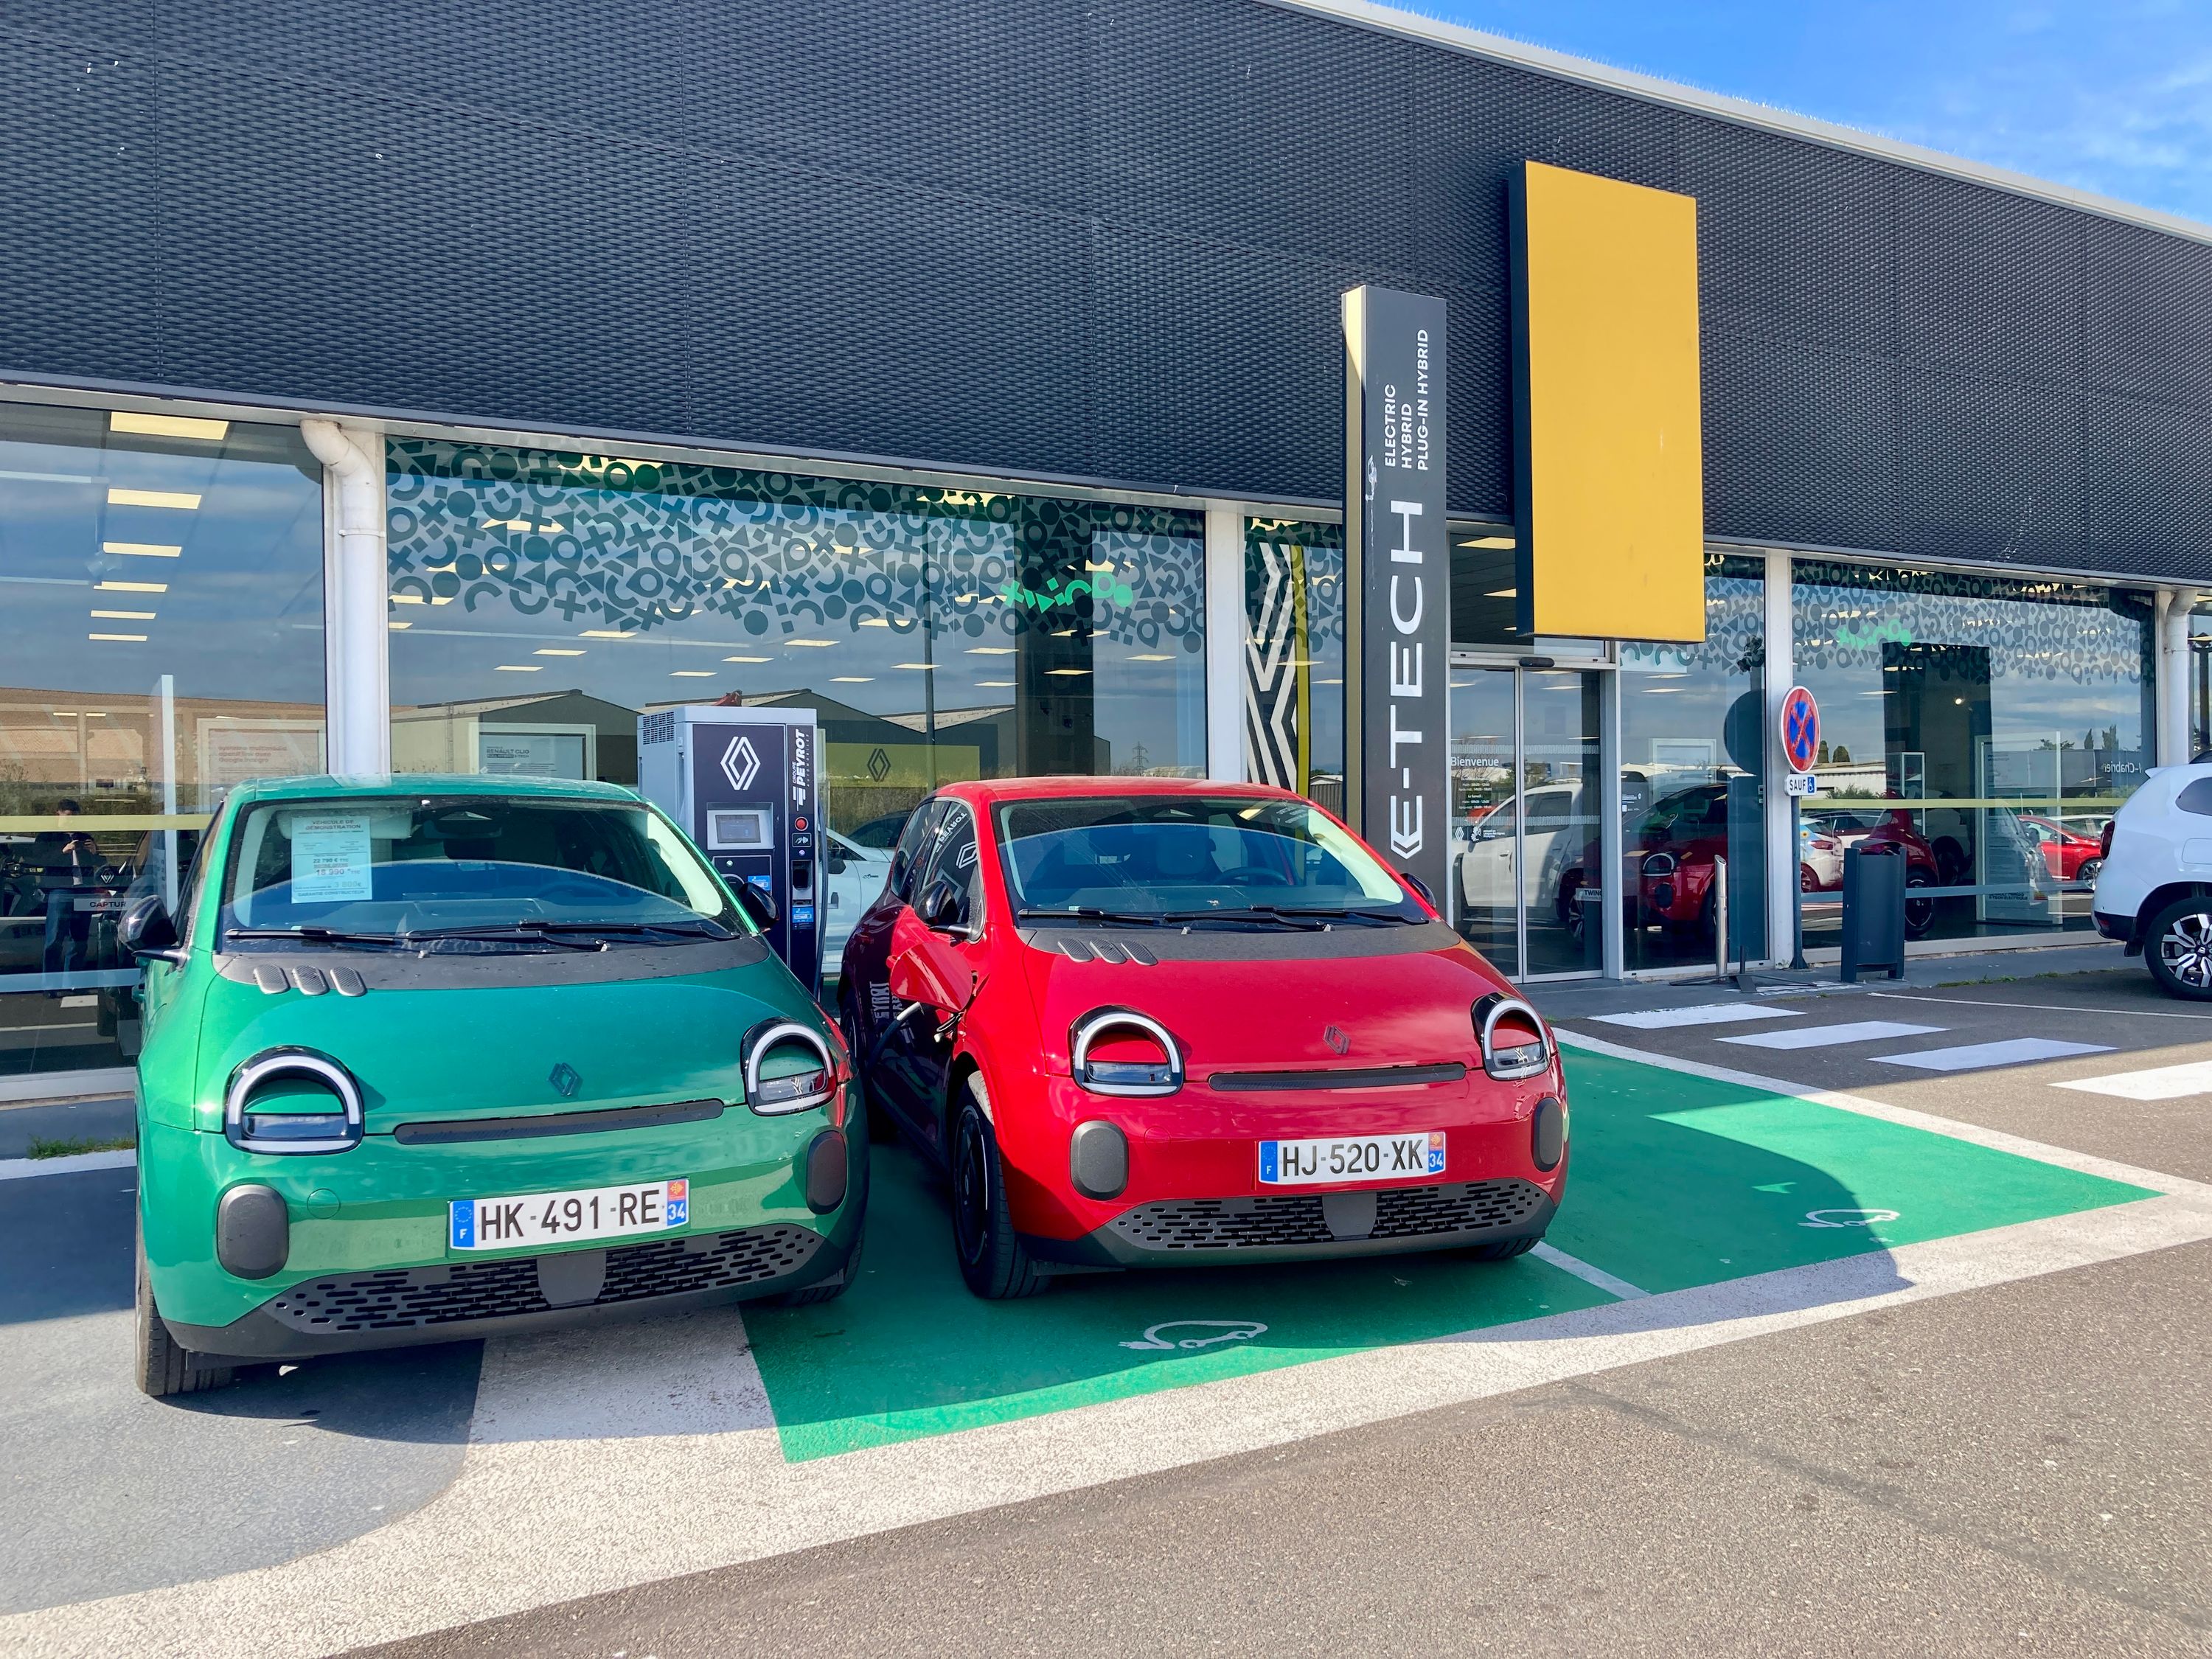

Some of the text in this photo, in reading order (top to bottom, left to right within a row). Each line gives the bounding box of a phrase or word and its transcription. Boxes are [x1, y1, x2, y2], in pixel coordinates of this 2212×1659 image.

[1385, 383, 1396, 467] ELECTRIC
[1417, 329, 1428, 470] PLUG-IN HYBRID
[1401, 403, 1412, 469] HYBRID
[1390, 500, 1422, 860] E-TECH
[796, 728, 806, 787] PEYROT
[1451, 756, 1499, 767] Bienvenue
[1790, 779, 1806, 791] SAUF
[1266, 1139, 1444, 1176] F HJ-520-XK 34
[459, 1189, 686, 1240] F HK-491-RE 34
